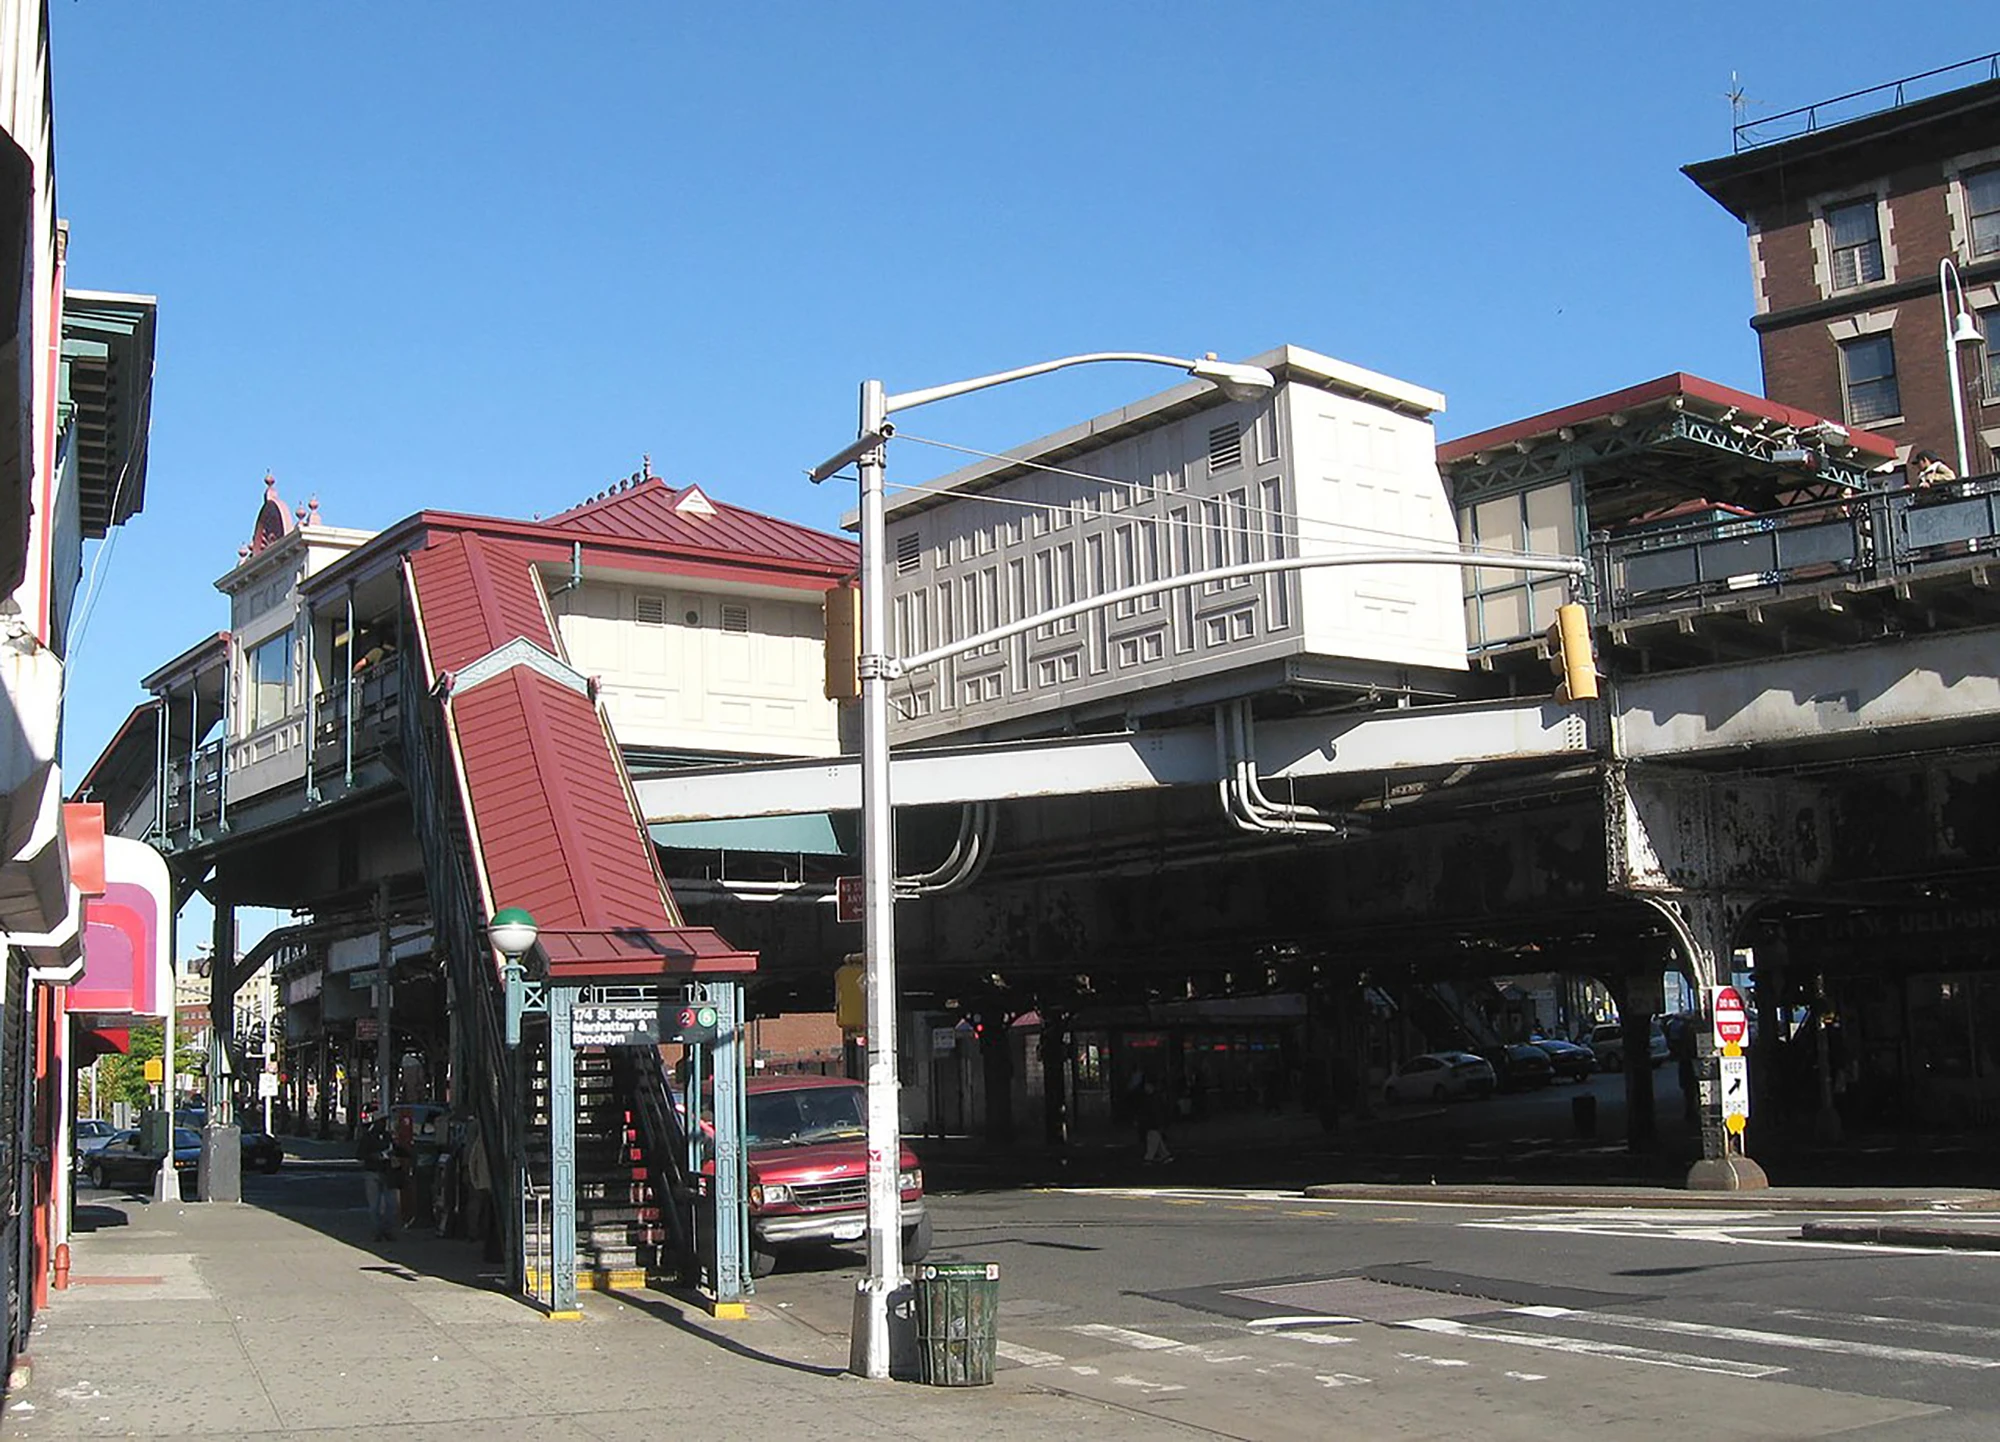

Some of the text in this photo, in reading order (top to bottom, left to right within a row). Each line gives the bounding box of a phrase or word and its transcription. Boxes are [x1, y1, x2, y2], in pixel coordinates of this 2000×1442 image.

[1719, 998, 1741, 1008] DO NOT
[573, 1008, 657, 1020] 174 St Station
[681, 1011, 690, 1024] 2
[572, 1020, 647, 1032] Manhattan &
[1721, 1024, 1741, 1035] ENTER
[572, 1033, 626, 1046] Brooklyn
[1724, 1061, 1742, 1074] KEEP
[1725, 1099, 1746, 1112] RIGHT
